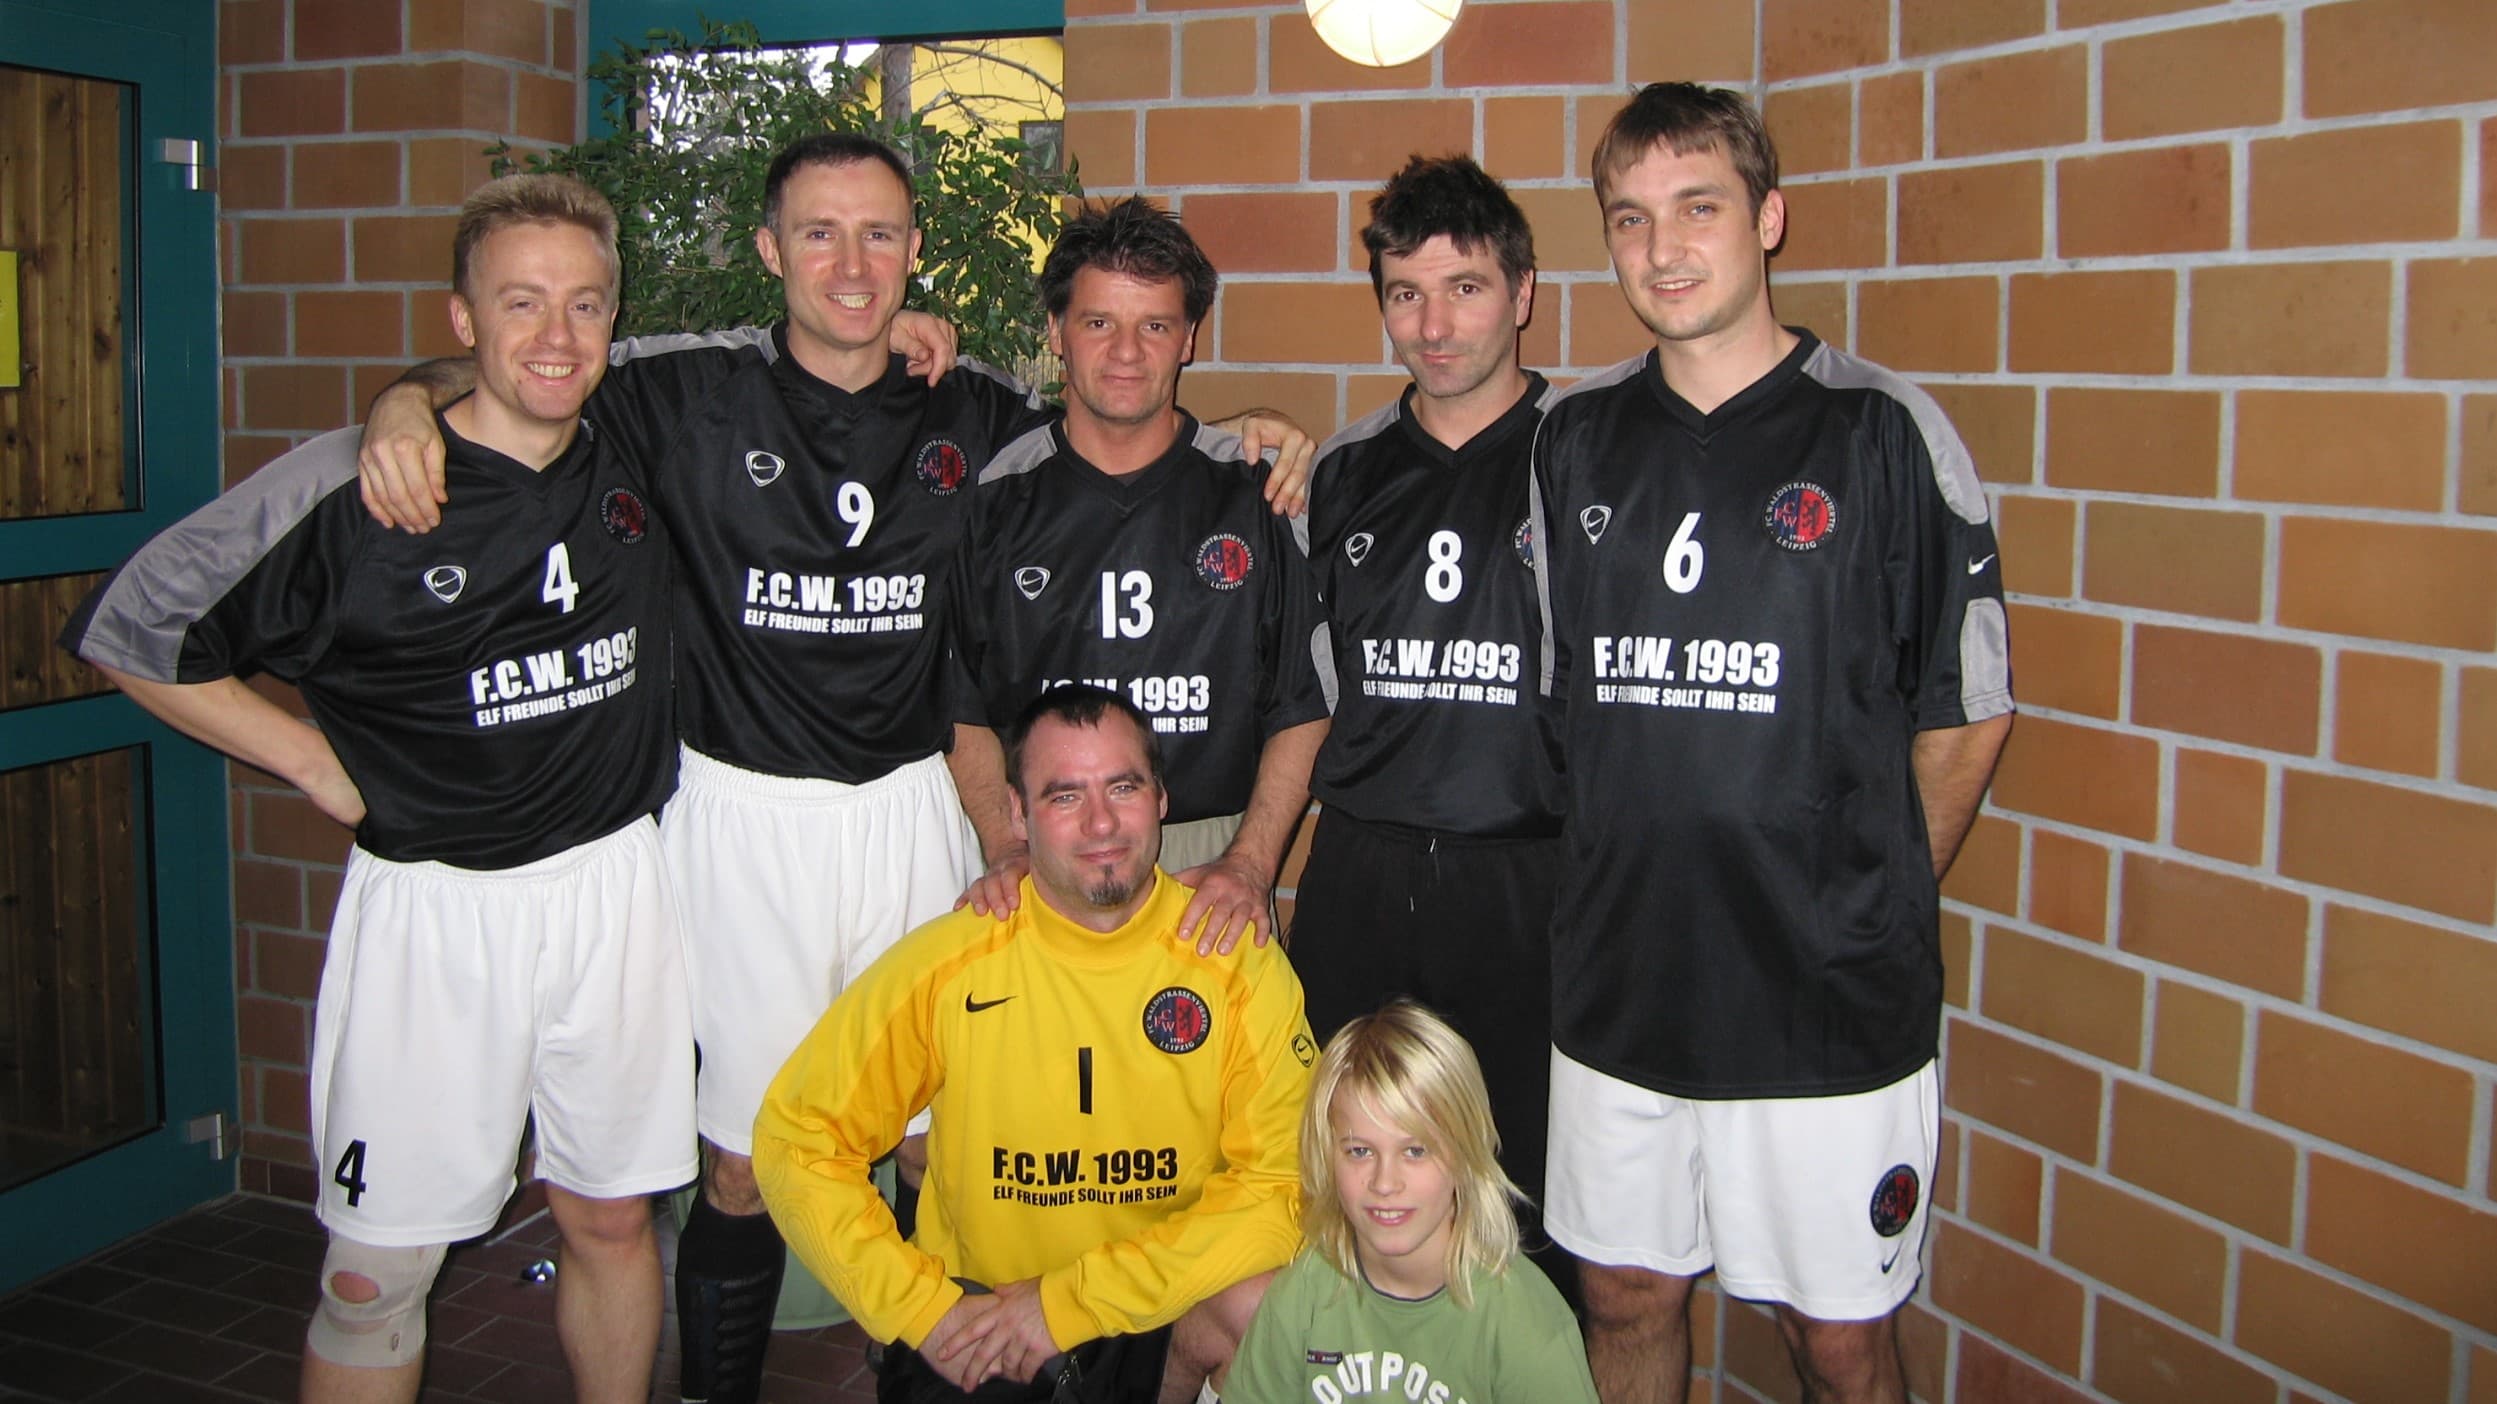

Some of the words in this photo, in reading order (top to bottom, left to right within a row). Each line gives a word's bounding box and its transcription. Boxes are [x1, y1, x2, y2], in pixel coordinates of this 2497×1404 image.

[836, 481, 875, 548] 9
[1424, 529, 1463, 603] 8
[1662, 512, 1704, 594] 6
[541, 541, 579, 613] 4
[746, 567, 841, 613] F.C.W.
[847, 574, 926, 613] 1993
[744, 609, 767, 626] ELF
[768, 612, 829, 633] FREUNDE
[831, 617, 870, 634] SOLLT
[870, 615, 893, 632] IHR
[895, 613, 923, 631] SEIN
[1101, 570, 1155, 639] 13
[471, 650, 574, 705] F.C.W.
[577, 626, 638, 681] 1993
[1440, 639, 1521, 682] 1993
[1684, 639, 1780, 687] 1993
[475, 707, 501, 727] ELF
[502, 694, 566, 723] FREUNDE
[567, 684, 604, 709] SOLLT
[1128, 675, 1210, 712] 1993
[1424, 682, 1458, 699] OLLT
[1459, 684, 1483, 702] IHR
[1486, 686, 1517, 706] SEIN
[1596, 684, 1618, 703] ELF
[1661, 687, 1703, 708] SOLLT
[1704, 690, 1735, 711] IHR
[1737, 693, 1776, 713] SEIN
[1179, 716, 1208, 733] SEIN
[335, 1139, 367, 1208] 4
[993, 1146, 1086, 1186] F.C.W.
[1093, 1147, 1178, 1185] 1993
[993, 1185, 1014, 1200] ELF
[1017, 1189, 1075, 1207] FREUNDE
[1078, 1188, 1116, 1205] SOLLT
[1119, 1188, 1143, 1204] IHR
[1146, 1184, 1177, 1200] SEIN
[1312, 1351, 1467, 1404] OUTPOS
